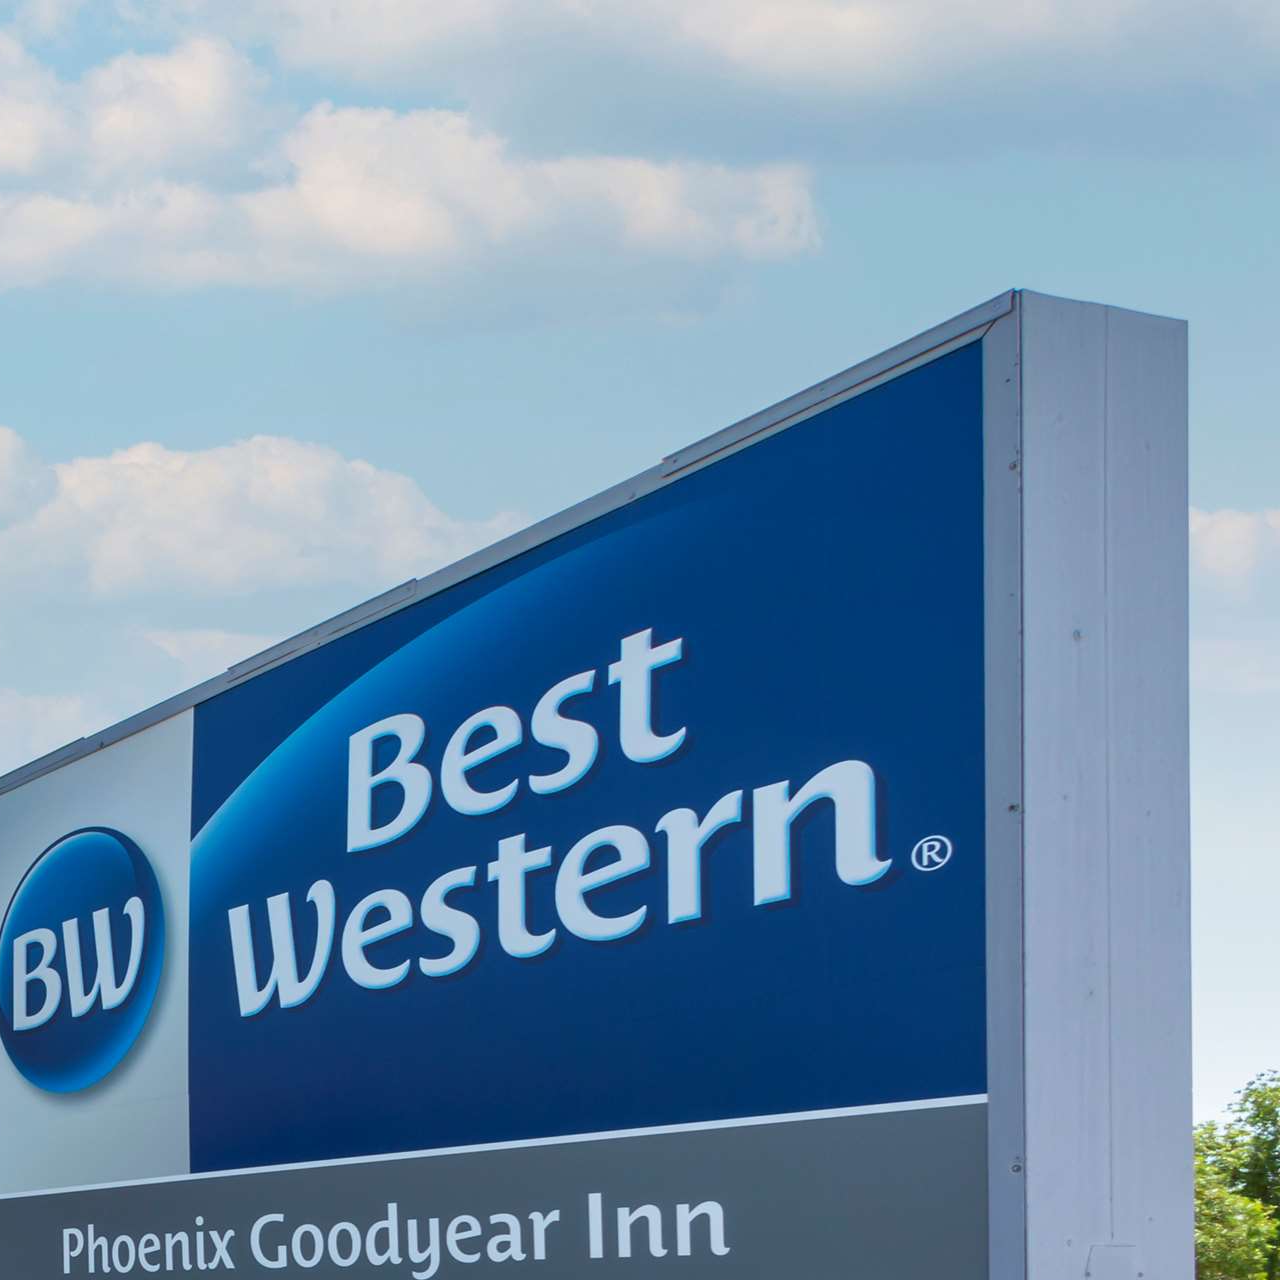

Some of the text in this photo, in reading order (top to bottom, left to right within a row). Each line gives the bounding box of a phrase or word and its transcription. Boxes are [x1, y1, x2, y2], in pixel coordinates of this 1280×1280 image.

[346, 626, 686, 853] Best
[10, 896, 146, 1033] BW
[228, 758, 894, 1018] Western
[61, 1192, 731, 1280] Phoenix Goodyear Inn
